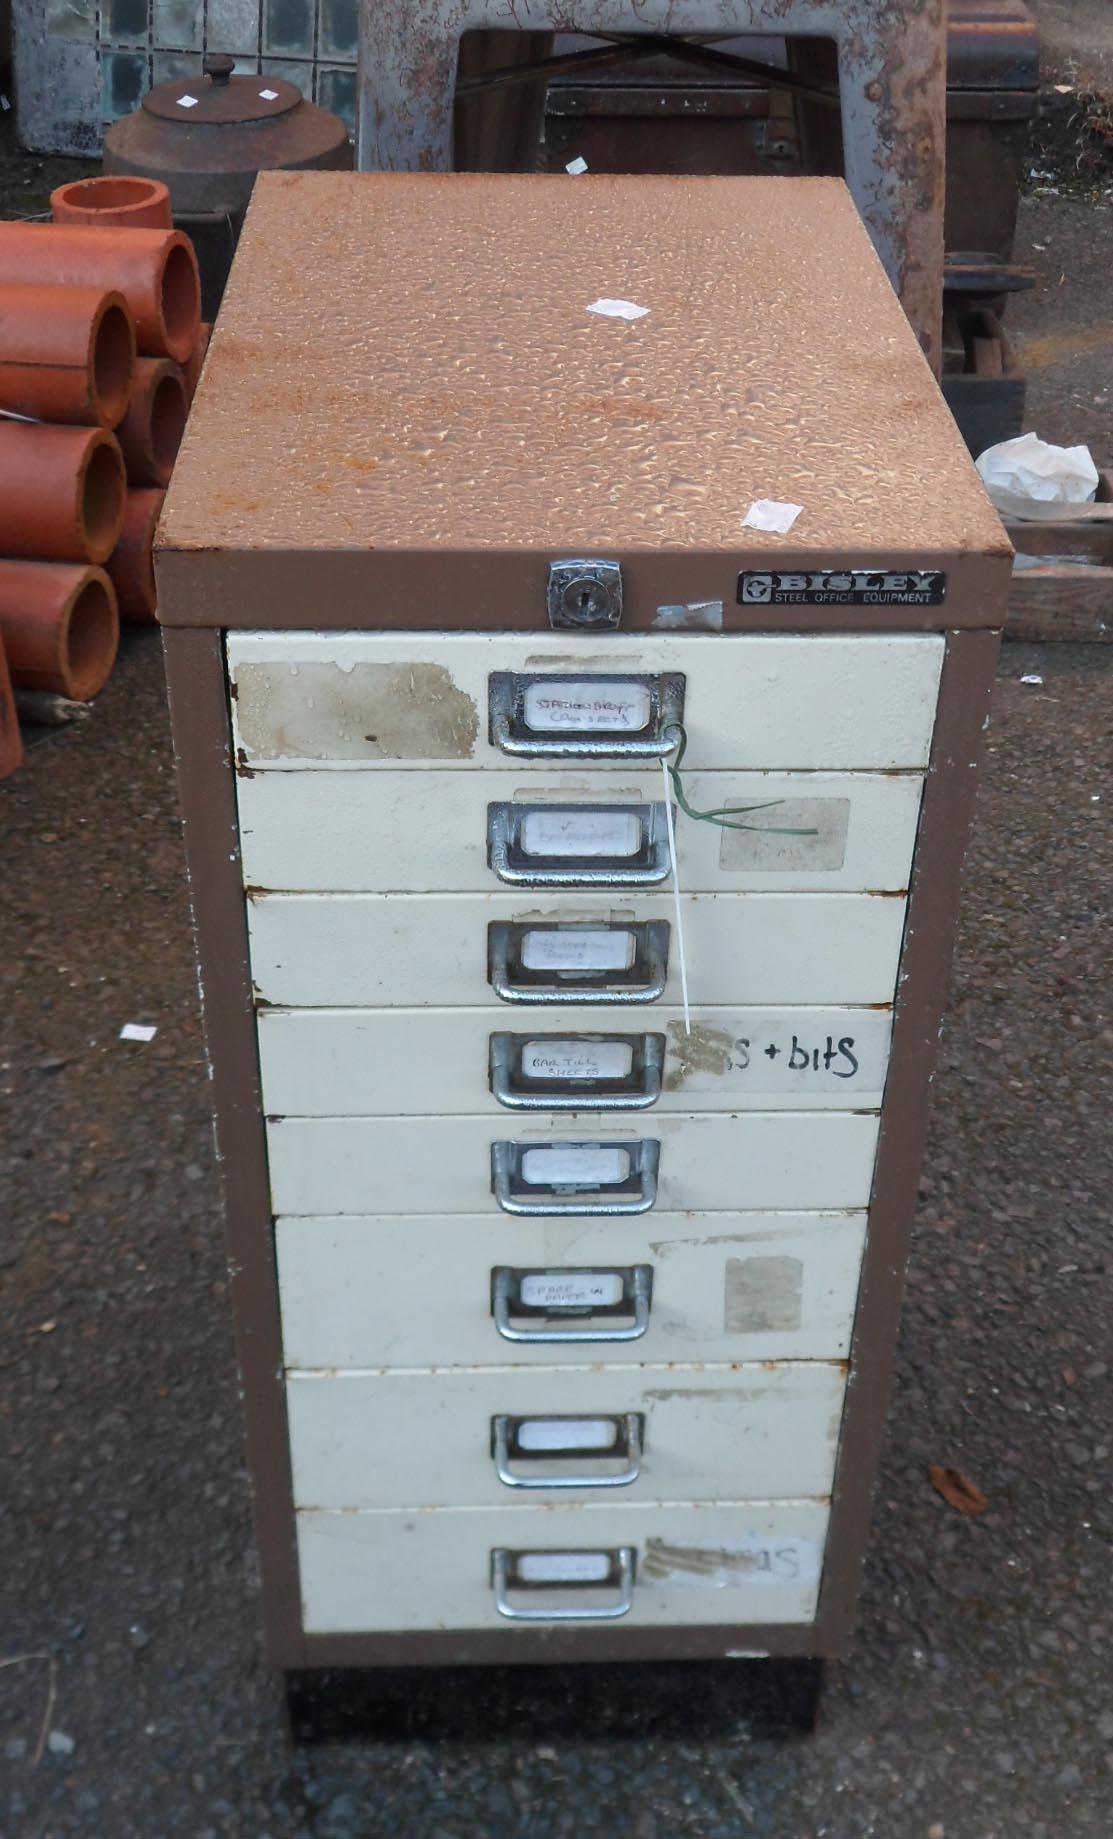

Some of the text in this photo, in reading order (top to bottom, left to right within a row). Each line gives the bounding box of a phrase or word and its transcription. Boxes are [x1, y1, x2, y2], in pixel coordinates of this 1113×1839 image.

[776, 575, 935, 591] BISLEY
[775, 593, 932, 602] STEEL OFFICE EQUIPMENT
